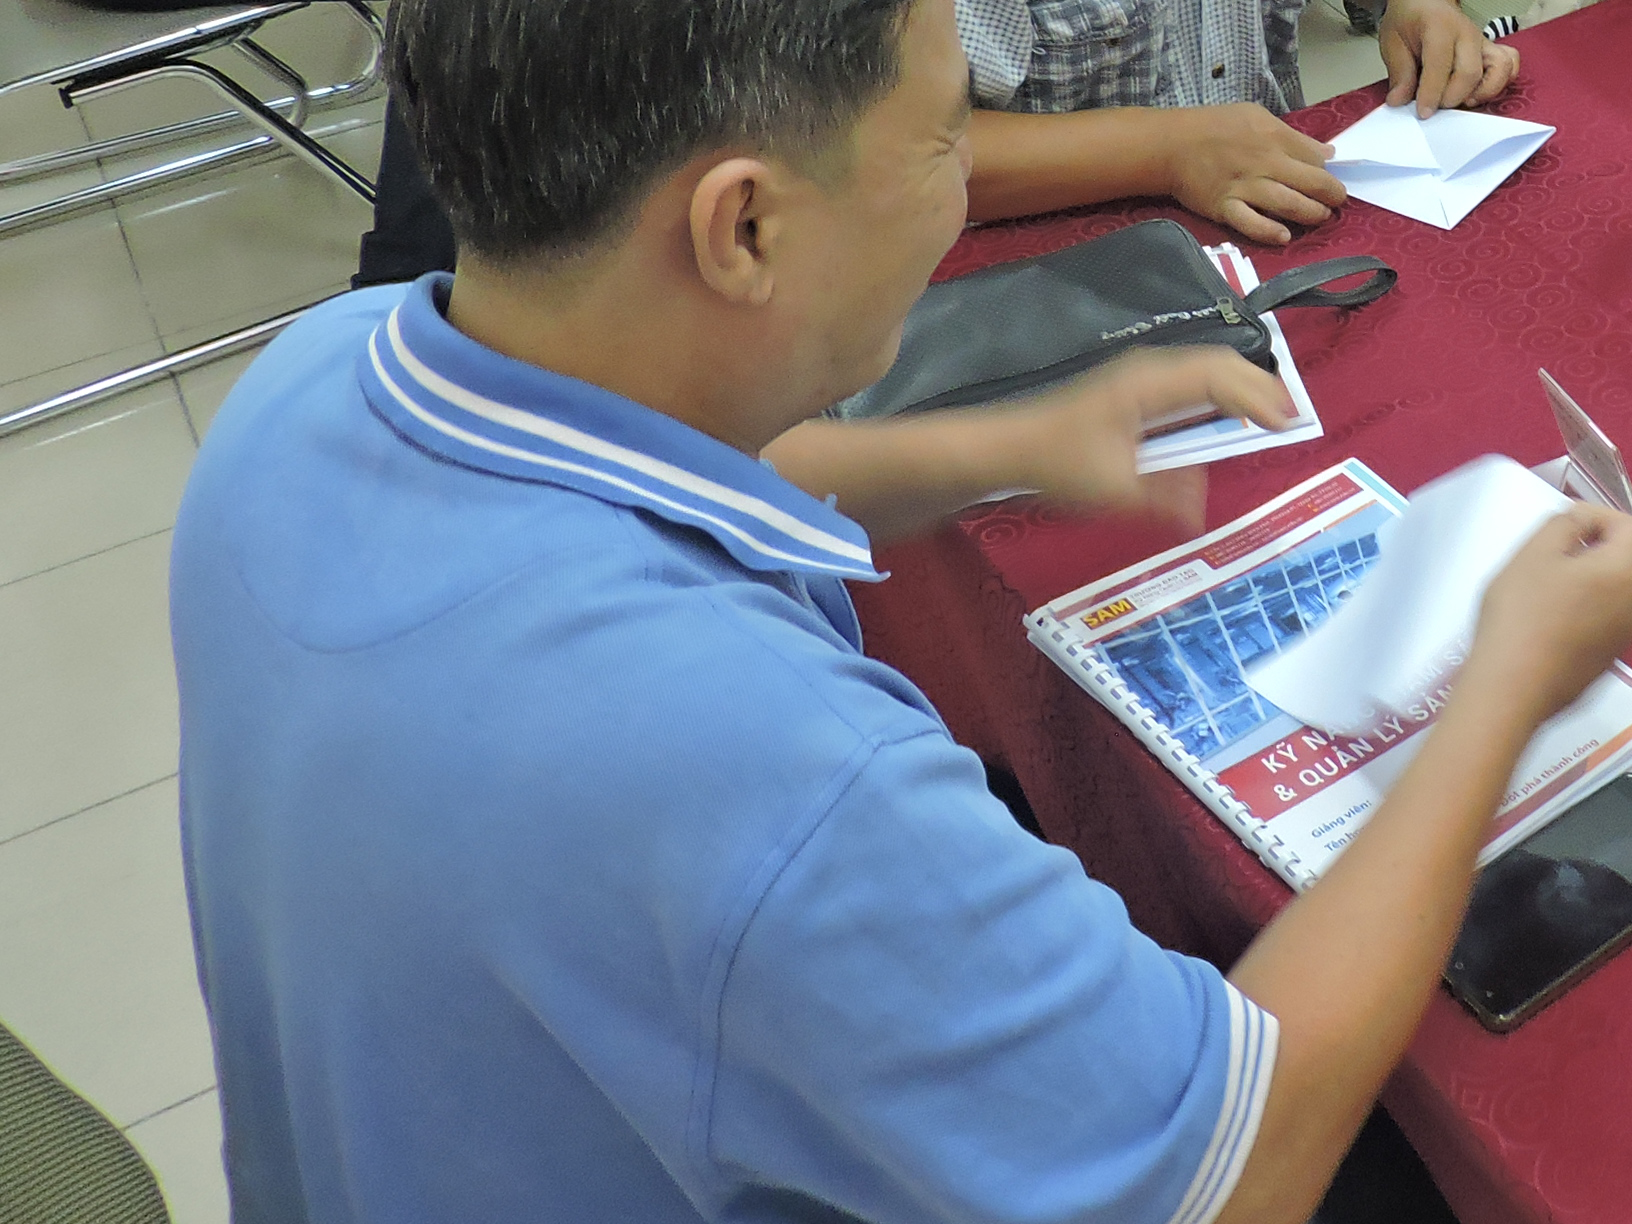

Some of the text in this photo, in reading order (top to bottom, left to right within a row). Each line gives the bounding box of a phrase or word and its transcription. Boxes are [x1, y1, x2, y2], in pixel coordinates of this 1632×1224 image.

[1083, 599, 1132, 628] SAM
[1261, 741, 1299, 774] KỸ
[1273, 784, 1298, 802] &
[1299, 736, 1375, 787] QUẢN
[1373, 715, 1404, 743] LÝ
[1312, 813, 1346, 839] Giảng
[1324, 835, 1346, 853] Tên
